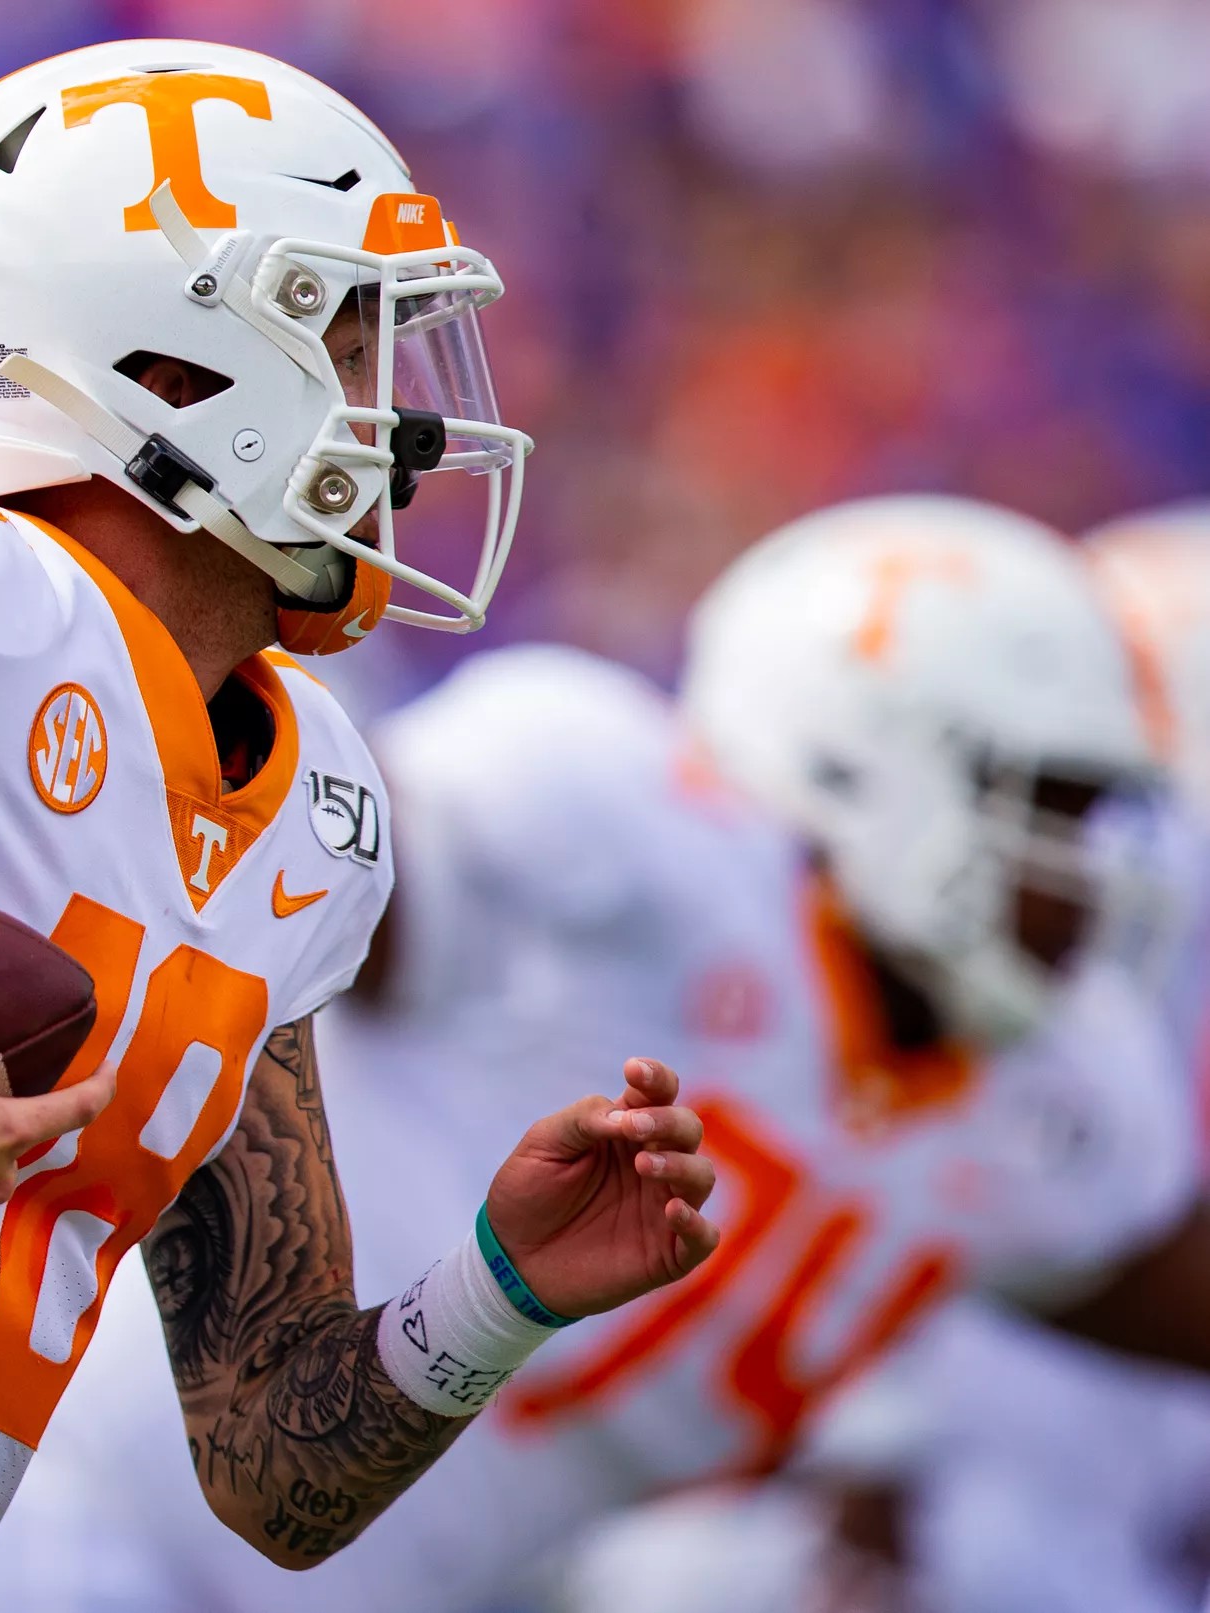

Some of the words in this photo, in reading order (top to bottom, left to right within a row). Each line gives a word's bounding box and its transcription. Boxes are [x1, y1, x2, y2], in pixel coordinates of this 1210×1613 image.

[60, 73, 272, 232] T
[396, 203, 425, 224] NIKE
[36, 690, 102, 804] SEC
[189, 813, 228, 893] T
[305, 767, 380, 863] 150
[490, 1255, 521, 1293] SET
[517, 1293, 556, 1326] THE
[290, 1478, 357, 1526] GOD
